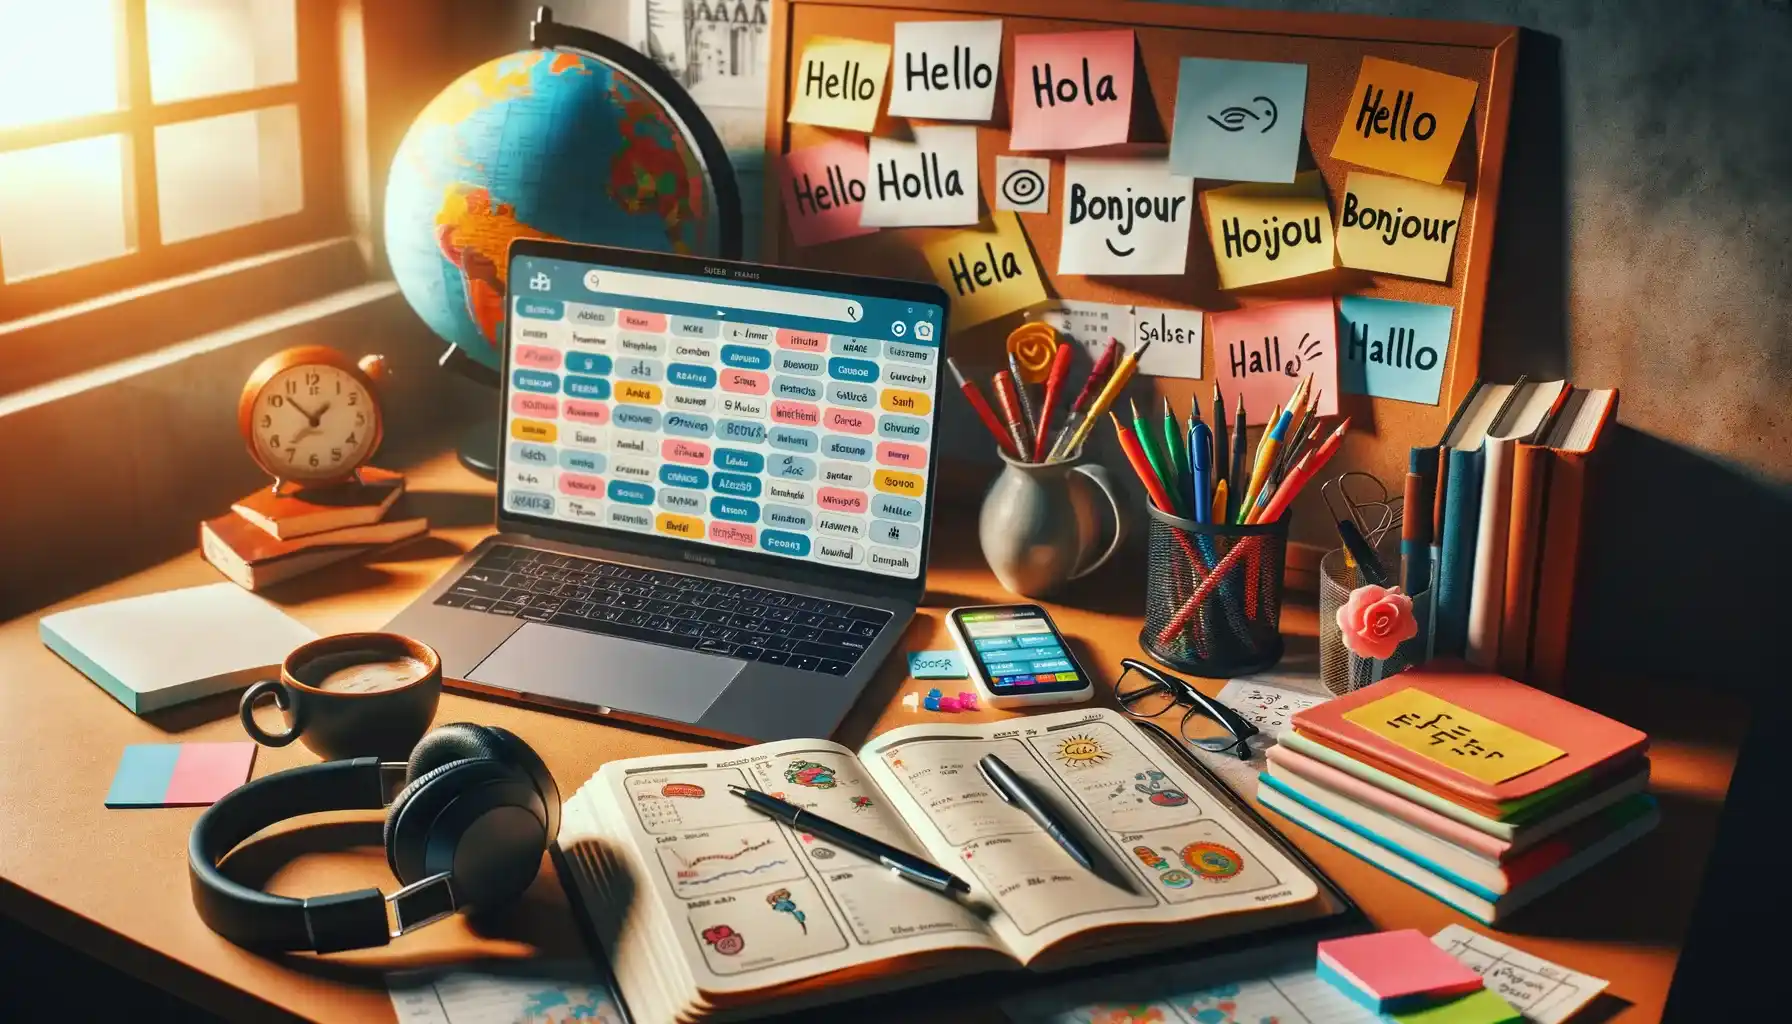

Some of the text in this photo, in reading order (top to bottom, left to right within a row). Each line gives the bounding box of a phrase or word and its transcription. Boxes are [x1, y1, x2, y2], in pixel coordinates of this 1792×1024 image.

[806, 61, 875, 100] Hello
[906, 46, 992, 91] Hello
[1032, 58, 1117, 108] Hola
[1356, 84, 1437, 142] Hello
[793, 165, 866, 216] Hello
[878, 152, 964, 201] Holla
[1069, 183, 1186, 235] Bonjour
[1342, 192, 1456, 246] Bonjour
[1222, 216, 1322, 261] Hoijou
[948, 242, 1021, 296] Hela
[1348, 321, 1438, 371] Halllo
[268, 395, 283, 408] 10
[286, 380, 297, 395] 11
[306, 373, 320, 386] 12
[336, 380, 341, 395] 1
[284, 447, 296, 464] 7
[309, 453, 319, 467] 6
